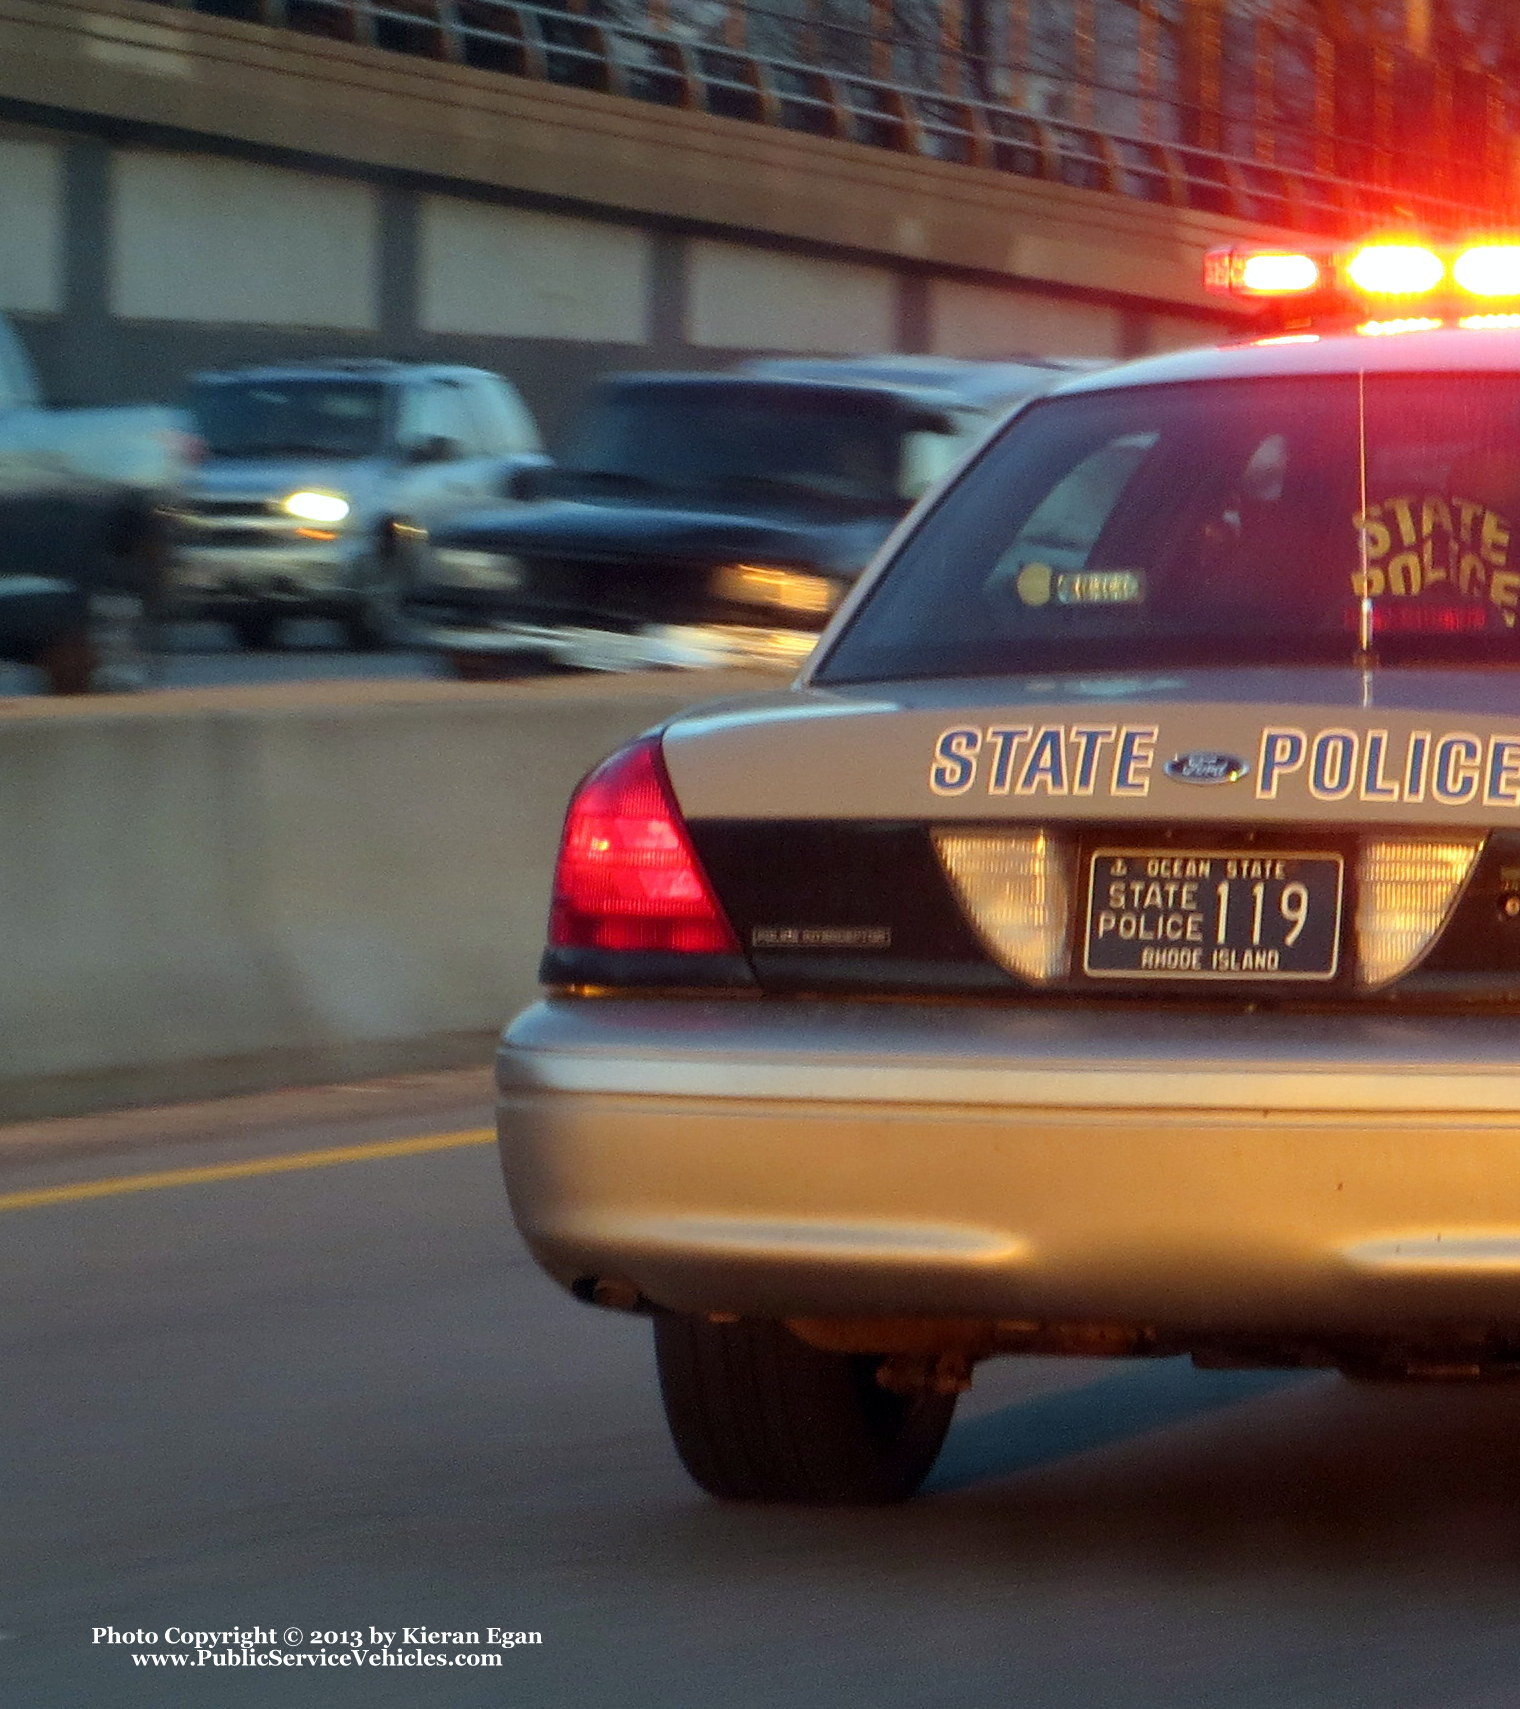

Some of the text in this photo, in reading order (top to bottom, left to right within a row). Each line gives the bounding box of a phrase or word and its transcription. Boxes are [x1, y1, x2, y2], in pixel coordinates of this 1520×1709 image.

[1352, 496, 1509, 566] STATE
[930, 724, 1158, 797] STATE
[1147, 858, 1287, 881] OCEAN STATE
[1108, 880, 1199, 912] STATE
[1098, 911, 1205, 943] POLICE
[1216, 880, 1309, 947] 119
[1141, 947, 1281, 971] RHODE ISLAND
